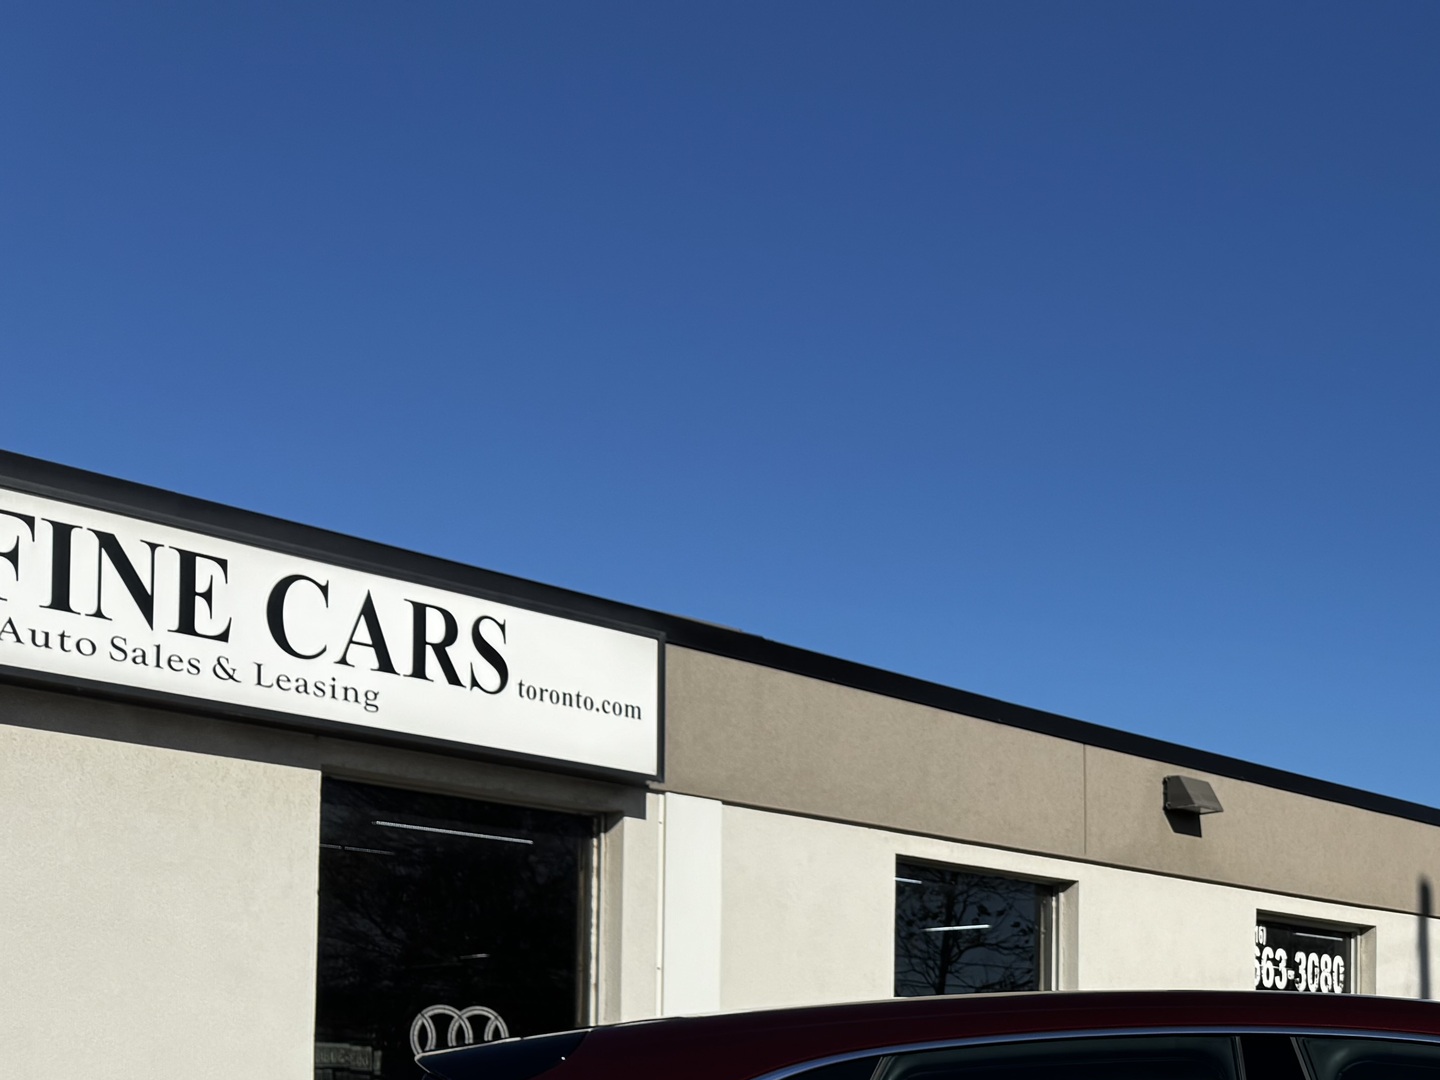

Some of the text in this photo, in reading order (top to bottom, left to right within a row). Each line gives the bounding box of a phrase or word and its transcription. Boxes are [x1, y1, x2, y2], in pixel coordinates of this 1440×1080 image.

[0, 509, 509, 695] FINE CARS
[0, 616, 380, 713] Auto Sales & Leasing
[518, 679, 642, 721] toronto.com
